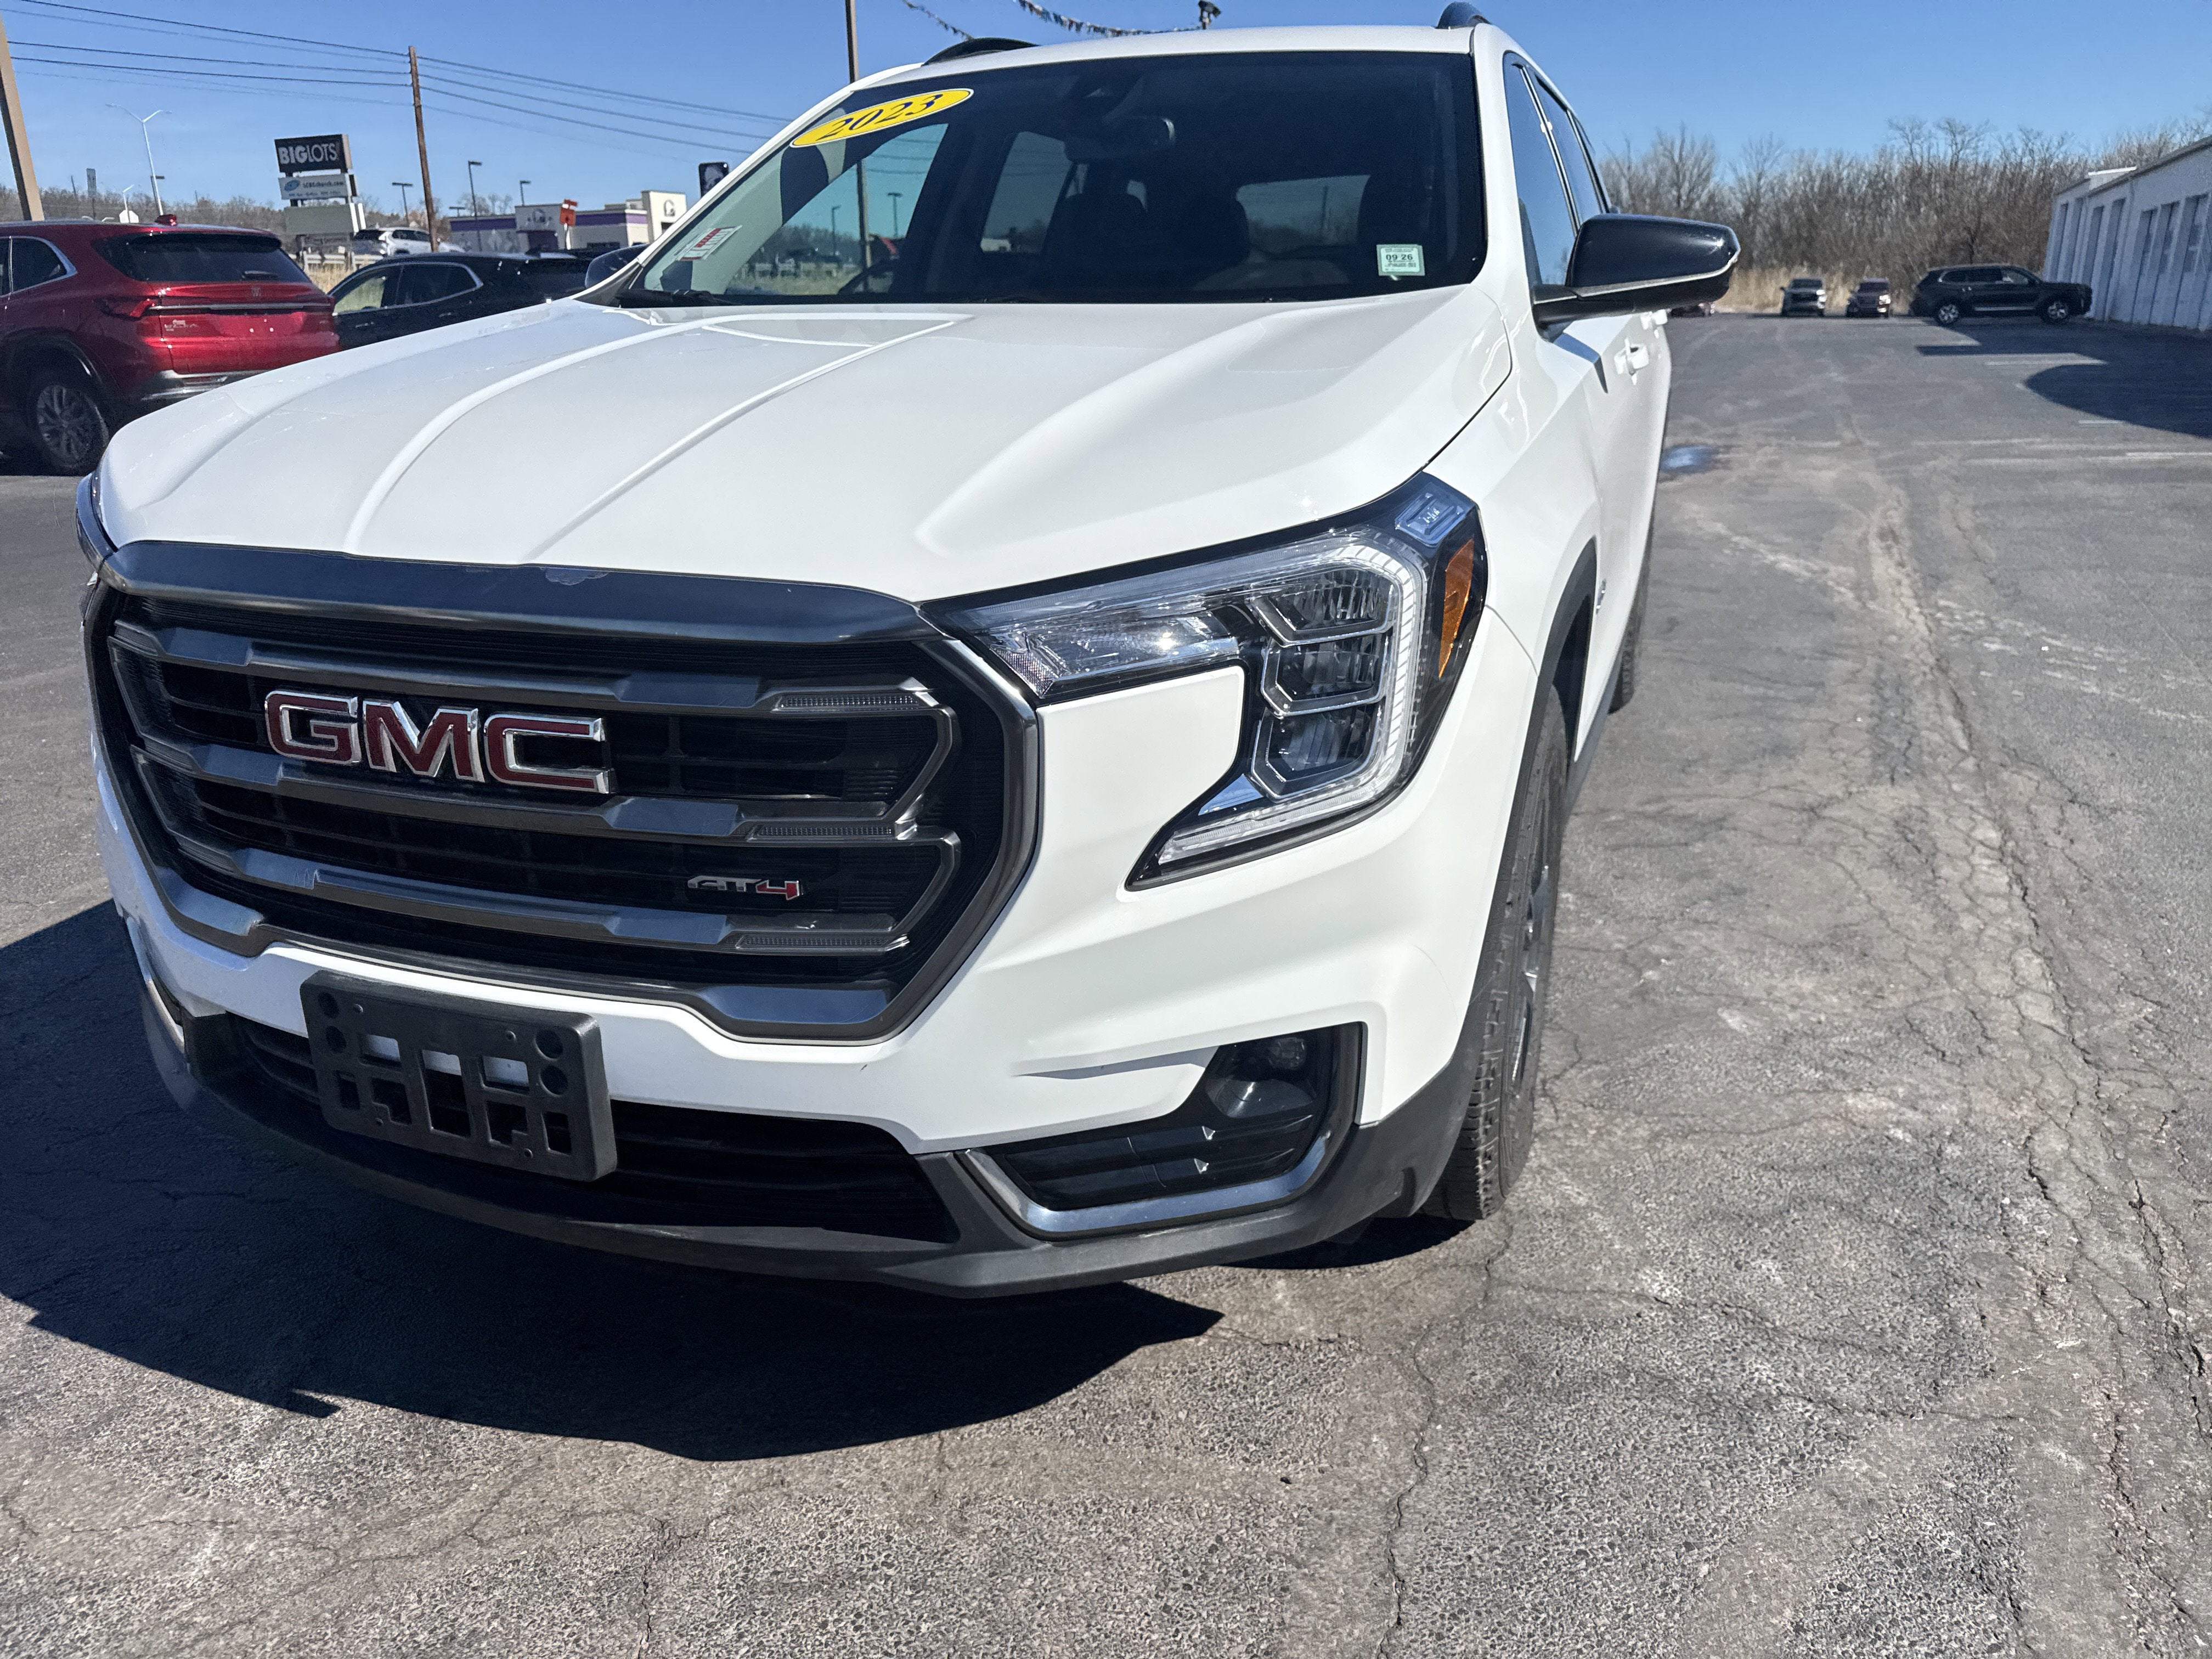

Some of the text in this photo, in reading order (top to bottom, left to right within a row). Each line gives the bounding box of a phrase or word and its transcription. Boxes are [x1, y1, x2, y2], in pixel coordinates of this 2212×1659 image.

[816, 93, 943, 141] 2023
[265, 690, 610, 794] GMC
[687, 875, 800, 901] AT4
